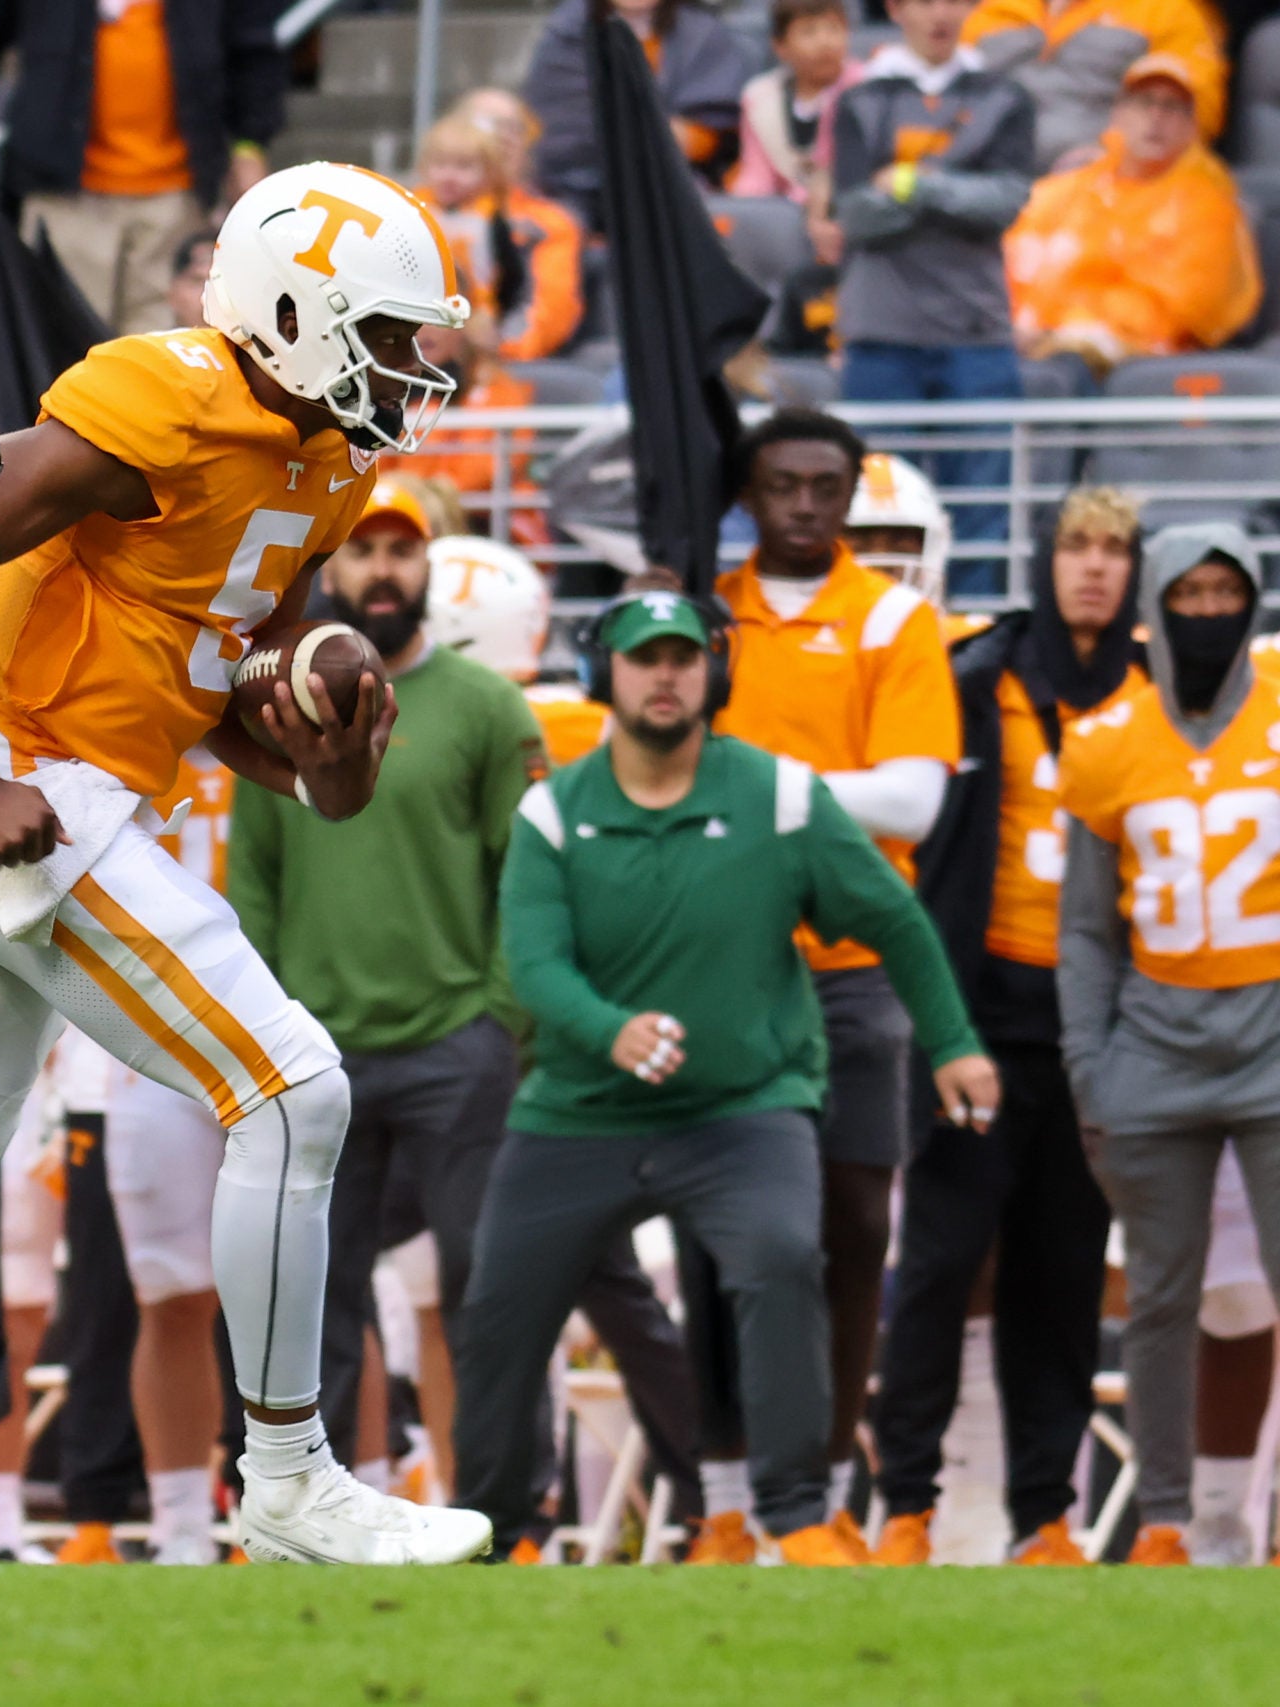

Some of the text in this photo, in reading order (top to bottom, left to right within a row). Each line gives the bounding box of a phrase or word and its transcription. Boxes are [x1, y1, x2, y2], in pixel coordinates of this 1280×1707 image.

[293, 189, 384, 278] T
[287, 461, 304, 491] T
[188, 508, 315, 692] 5
[642, 591, 678, 620] T
[1123, 786, 1280, 953] 82
